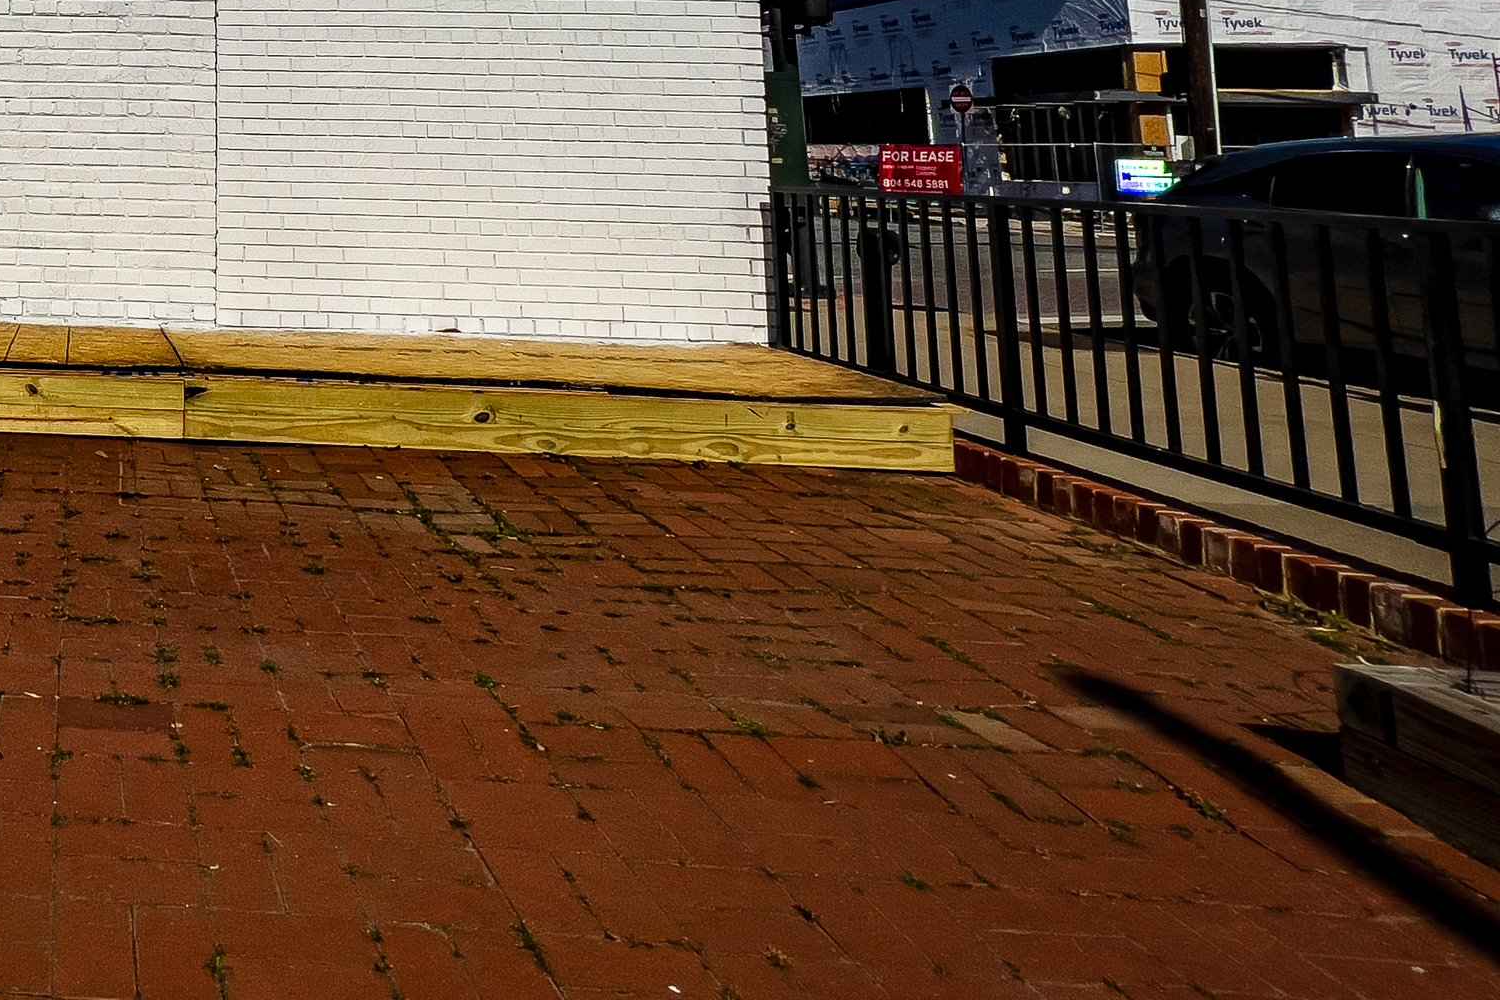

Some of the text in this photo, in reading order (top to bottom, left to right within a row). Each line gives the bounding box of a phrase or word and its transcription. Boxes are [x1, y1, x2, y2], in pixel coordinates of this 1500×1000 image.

[1222, 17, 1262, 29] Tyvek
[1450, 49, 1492, 62] Tyvek
[882, 151, 955, 162] FOR LEASE
